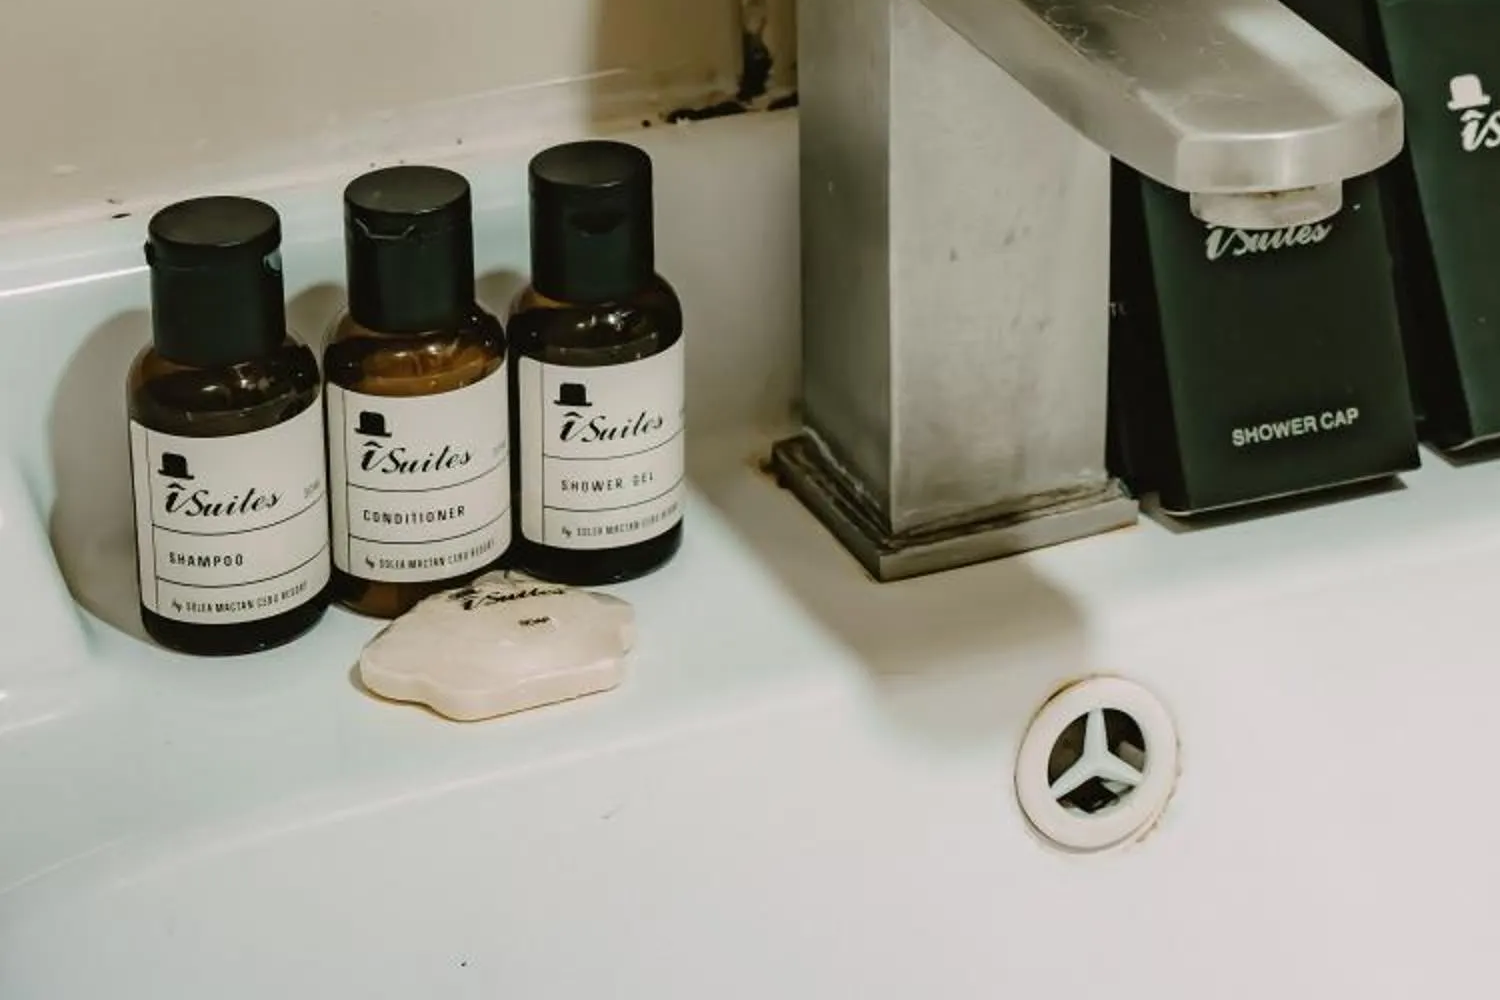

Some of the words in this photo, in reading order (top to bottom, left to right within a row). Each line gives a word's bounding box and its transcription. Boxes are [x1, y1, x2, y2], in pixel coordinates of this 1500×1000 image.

[1231, 415, 1318, 447] SHOWER
[1319, 407, 1360, 430] CAP
[560, 478, 623, 493] SHOWER
[632, 471, 654, 487] GEL
[362, 505, 466, 525] CONDITIONER
[168, 551, 244, 568] SHAMPOO
